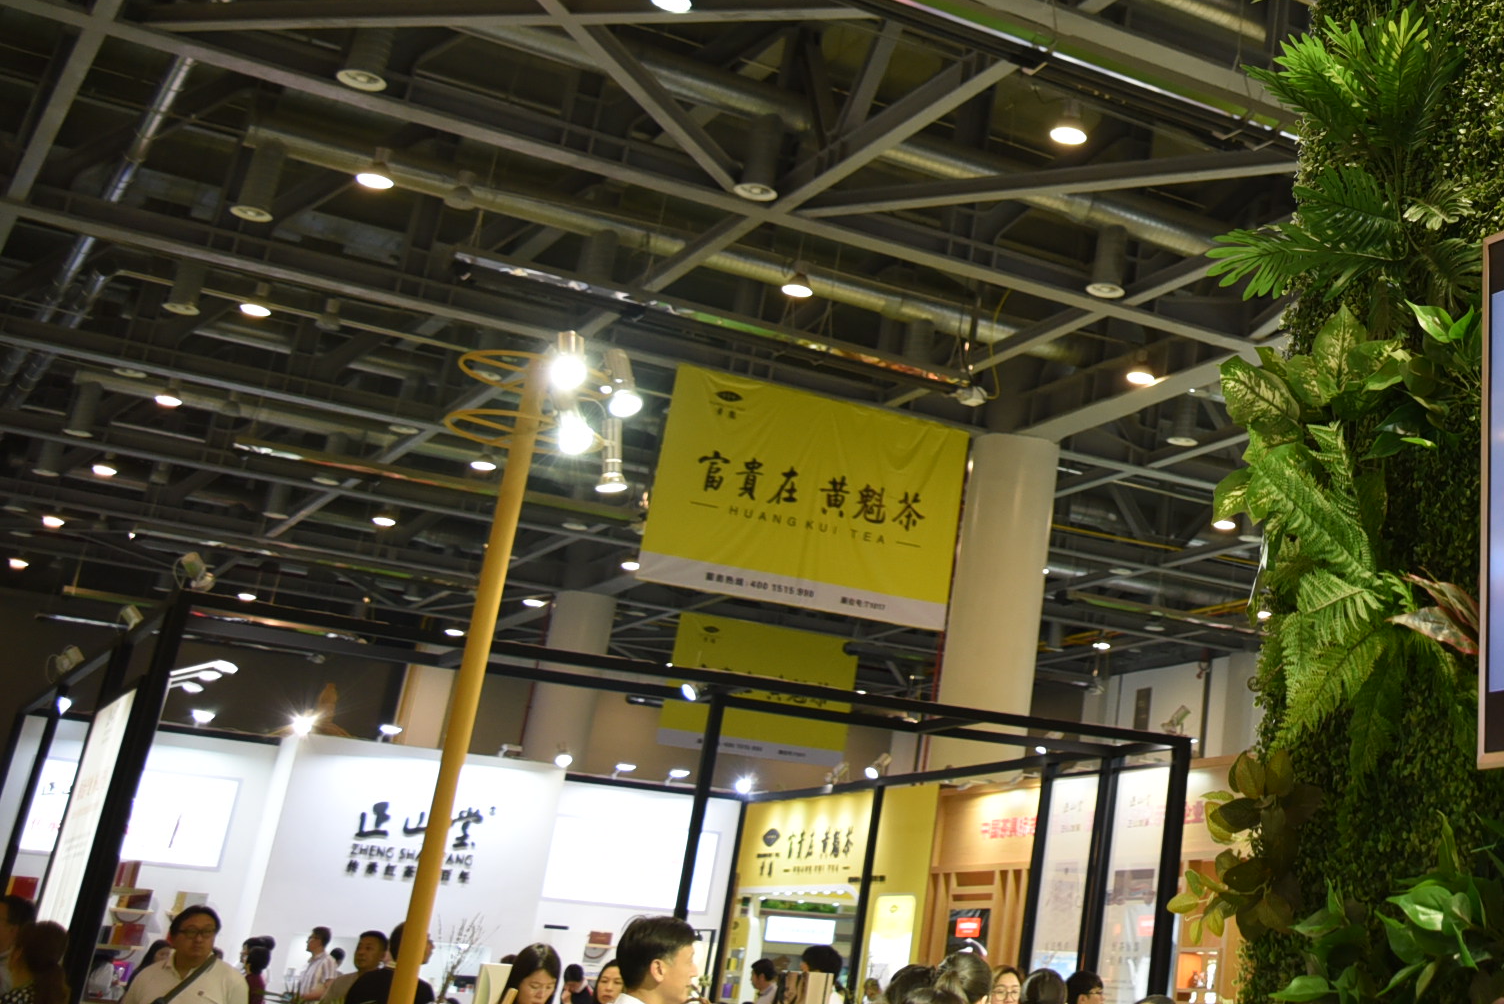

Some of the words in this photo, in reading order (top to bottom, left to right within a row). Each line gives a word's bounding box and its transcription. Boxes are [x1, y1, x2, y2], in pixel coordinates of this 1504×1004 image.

[728, 505, 797, 528] HUANG
[805, 520, 838, 535] KUI
[850, 528, 885, 545] TEA
[350, 843, 395, 861] ZHENG
[445, 852, 474, 867] ANG
